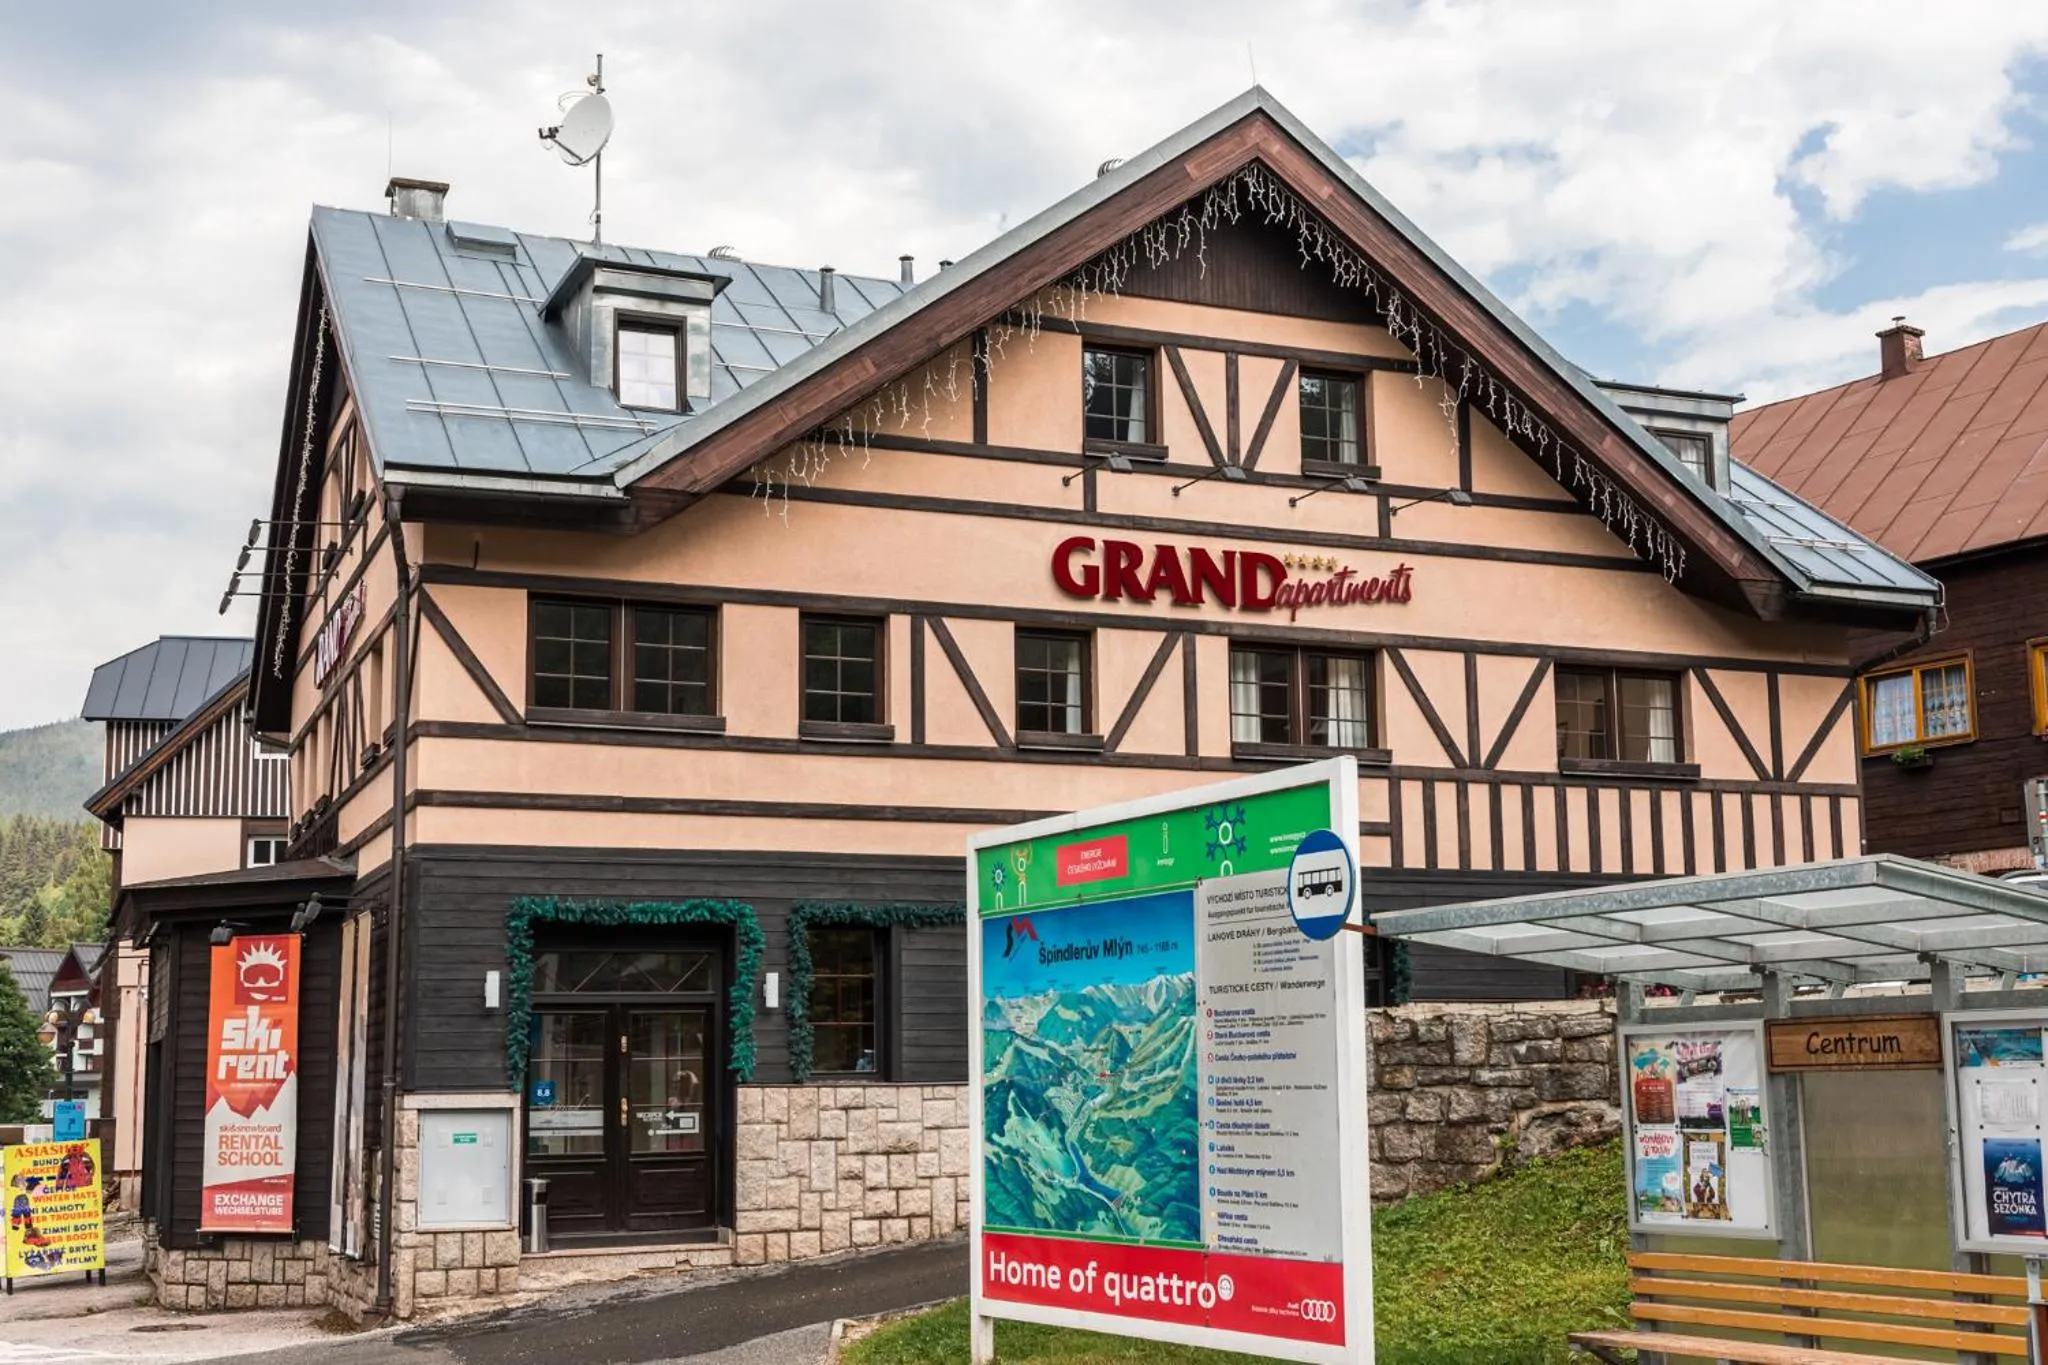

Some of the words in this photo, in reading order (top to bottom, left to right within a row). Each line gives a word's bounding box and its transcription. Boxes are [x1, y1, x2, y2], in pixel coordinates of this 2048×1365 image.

[1052, 536, 1288, 613] GRAND
[1276, 562, 1414, 622] apartments
[1039, 939, 1100, 967] Špindlerův
[1103, 936, 1133, 960] Mlýn
[1250, 981, 1273, 992] CESTY
[221, 1005, 282, 1053] ski
[1806, 1031, 1902, 1056] Centrum
[217, 1050, 290, 1080] rent
[218, 1134, 284, 1150] RENTAL
[218, 1151, 283, 1166] SCHOOL
[32, 1194, 70, 1203] WINTER
[73, 1191, 97, 1200] HATS
[215, 1193, 284, 1206] EXCHANGE
[42, 1203, 85, 1213] KALHOTY
[214, 1206, 284, 1216] WECHSELSTUBE
[49, 1211, 99, 1221] TROUSERS
[43, 1225, 70, 1235] ZIMNÍ
[74, 1223, 98, 1232] BOTY
[66, 1232, 99, 1242] BOOTS
[66, 1255, 98, 1264] HELMY
[989, 1250, 1061, 1290] Home
[1068, 1262, 1097, 1293] of
[1104, 1269, 1216, 1309] quattro
